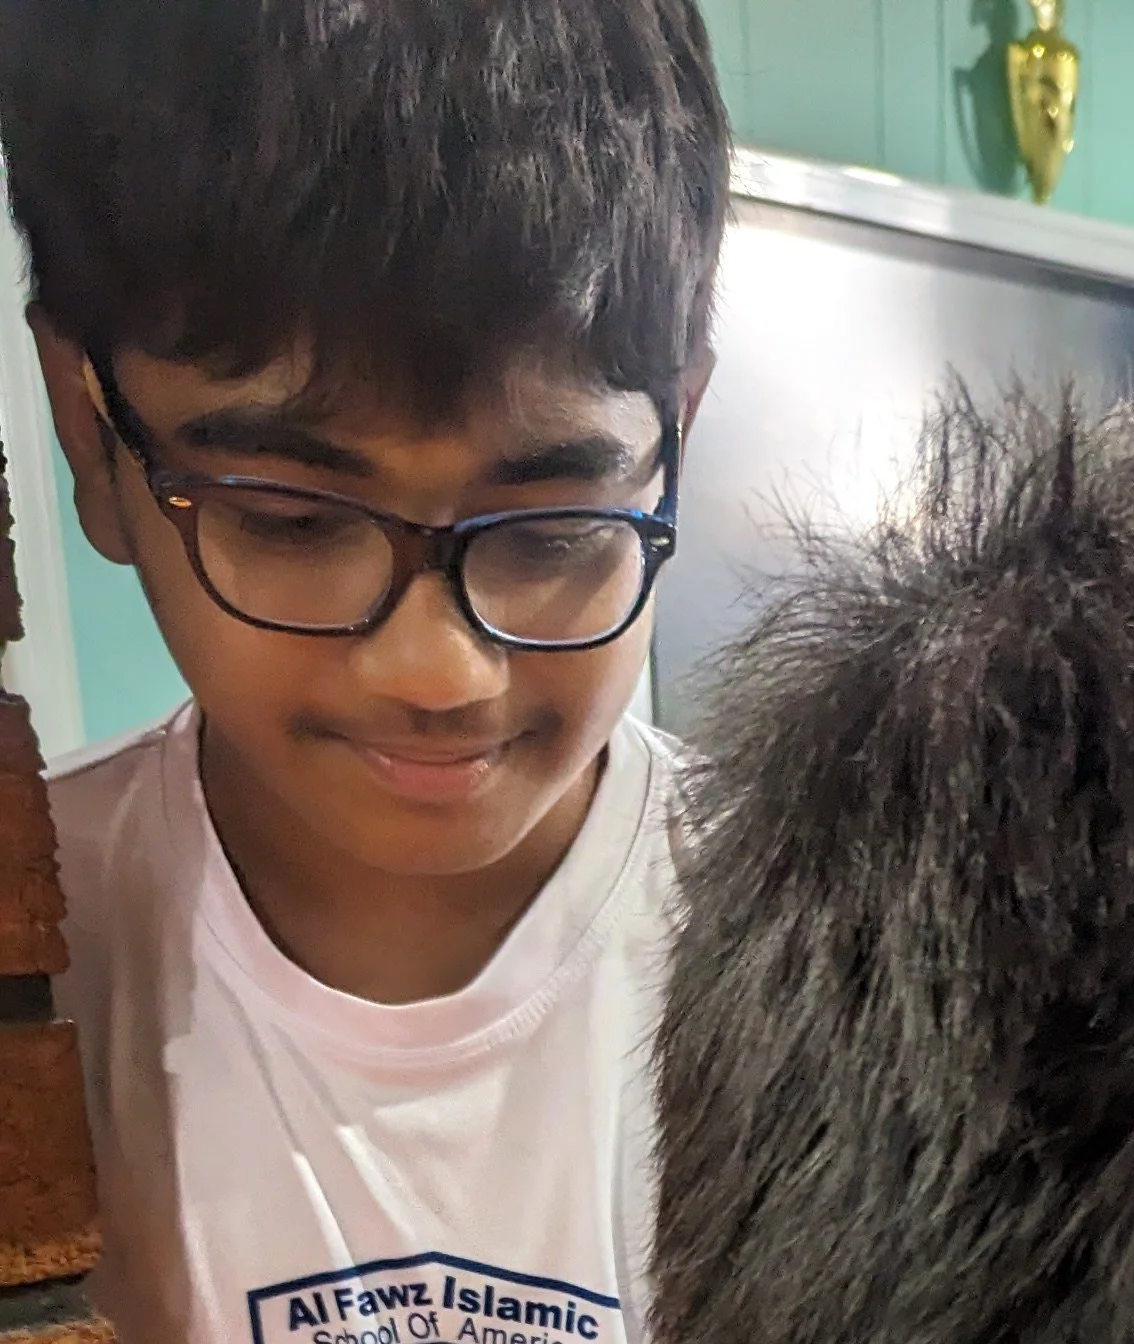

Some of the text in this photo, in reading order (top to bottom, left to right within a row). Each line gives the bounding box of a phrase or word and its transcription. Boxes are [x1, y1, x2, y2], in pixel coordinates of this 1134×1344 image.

[289, 1275, 599, 1341] Al Fawz Islamic
[407, 1311, 441, 1340] Of
